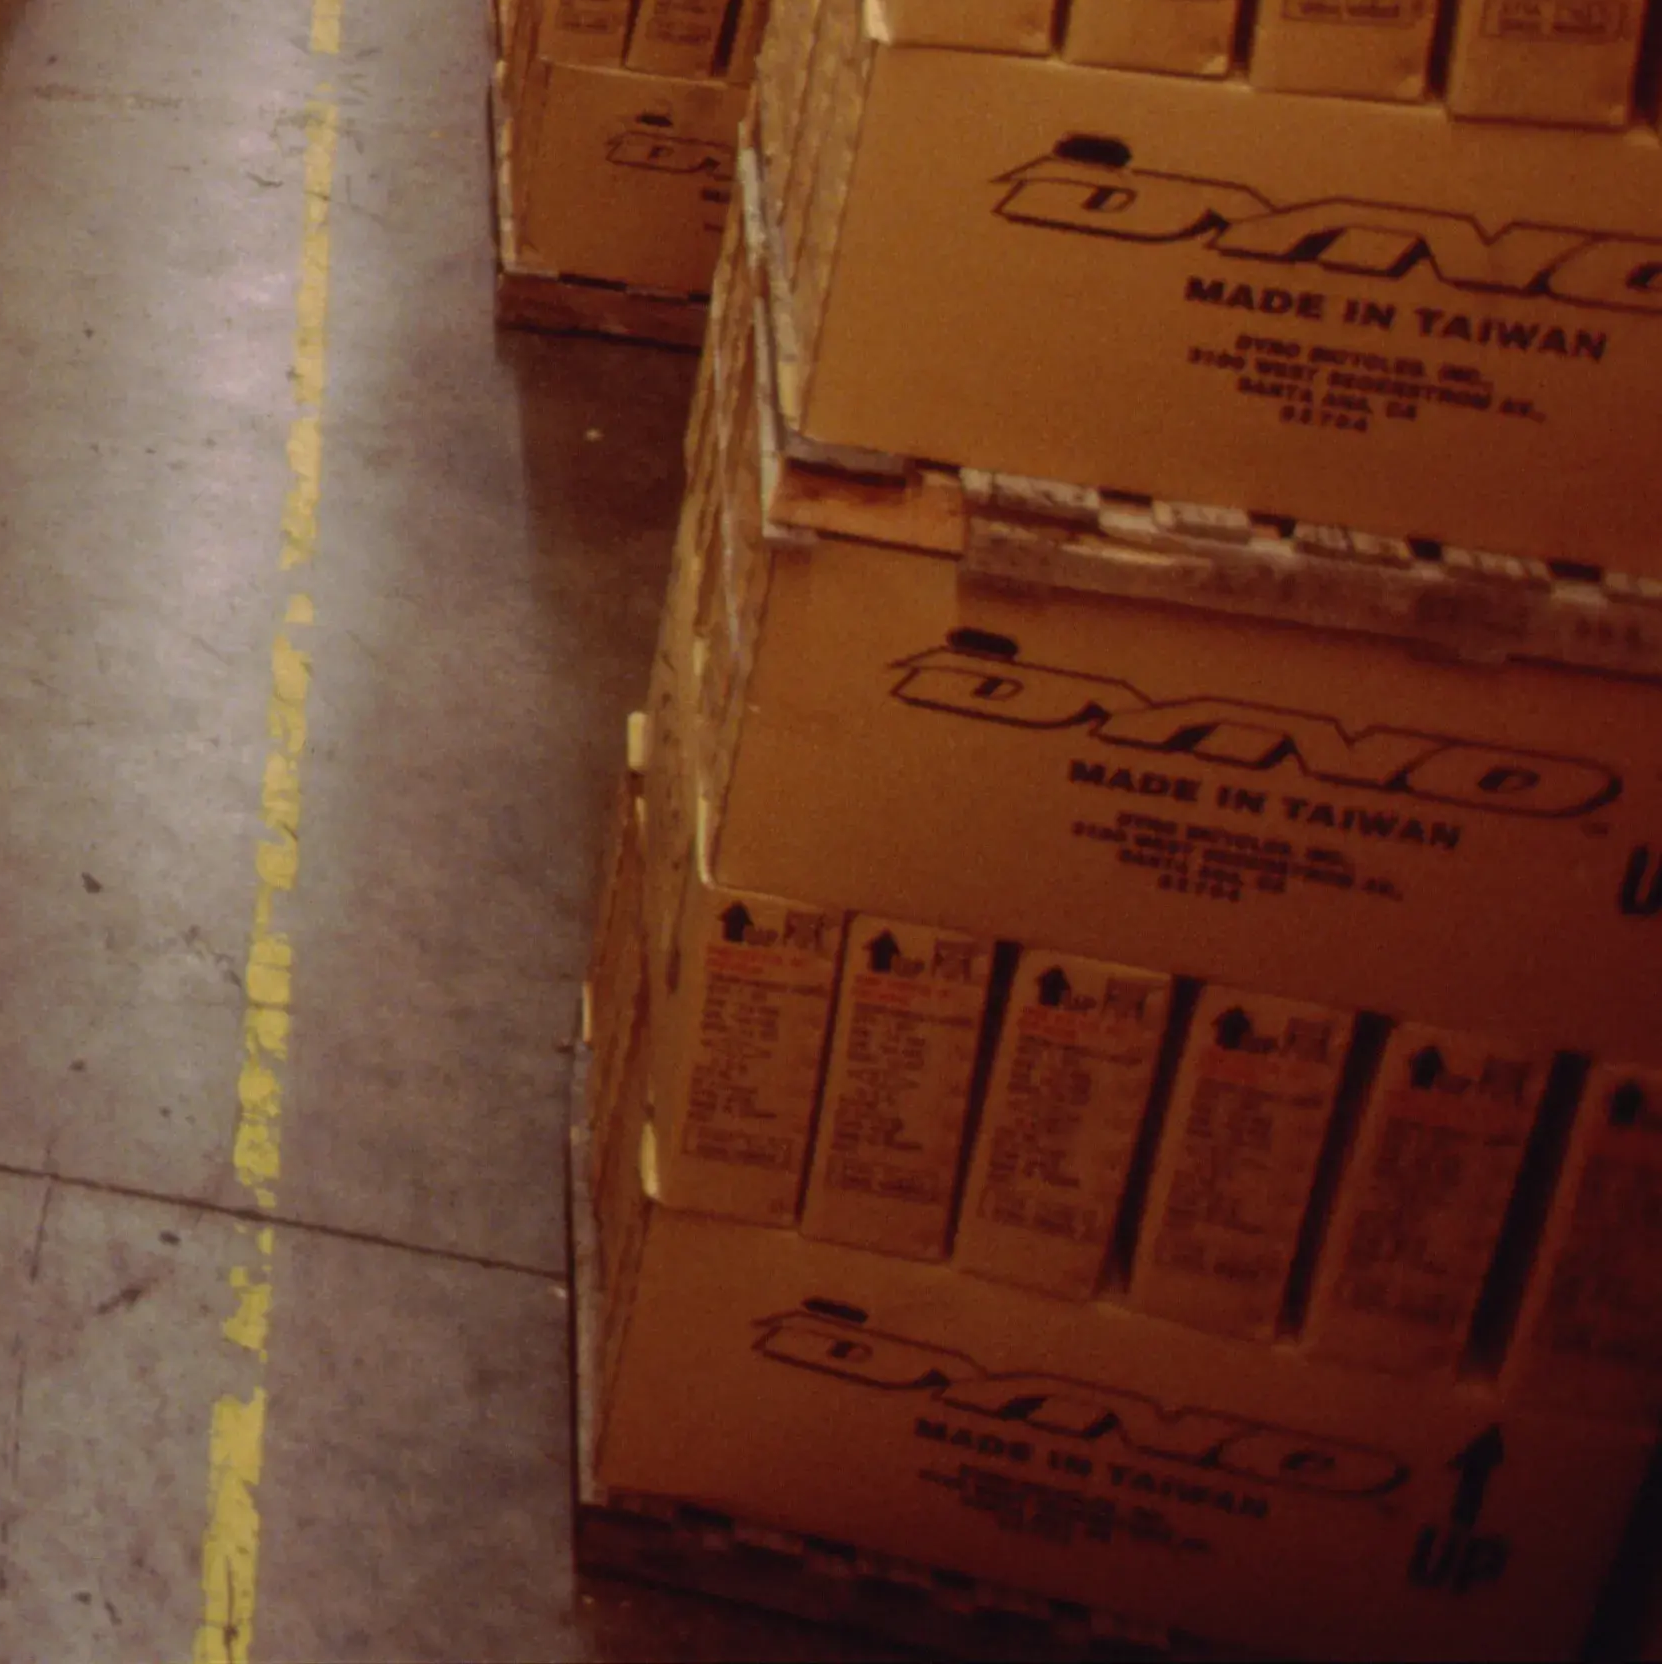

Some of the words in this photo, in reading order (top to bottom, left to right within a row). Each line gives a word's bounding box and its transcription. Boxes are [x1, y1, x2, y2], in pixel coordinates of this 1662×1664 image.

[1184, 276, 1325, 321] MADE
[1343, 297, 1396, 329] IN
[1413, 307, 1610, 362] TAIWAN
[1235, 333, 1302, 361] DYNO
[887, 645, 1624, 819] DYNO
[1068, 758, 1200, 805] MADE
[1217, 781, 1266, 816] IN
[1281, 792, 1462, 851] TAIWAN
[752, 1310, 1410, 1501] DYNO
[914, 1417, 1034, 1462] MADE
[1047, 1449, 1094, 1478] IN
[1105, 1462, 1270, 1520] TAIWAN
[1408, 1524, 1507, 1592] UP
